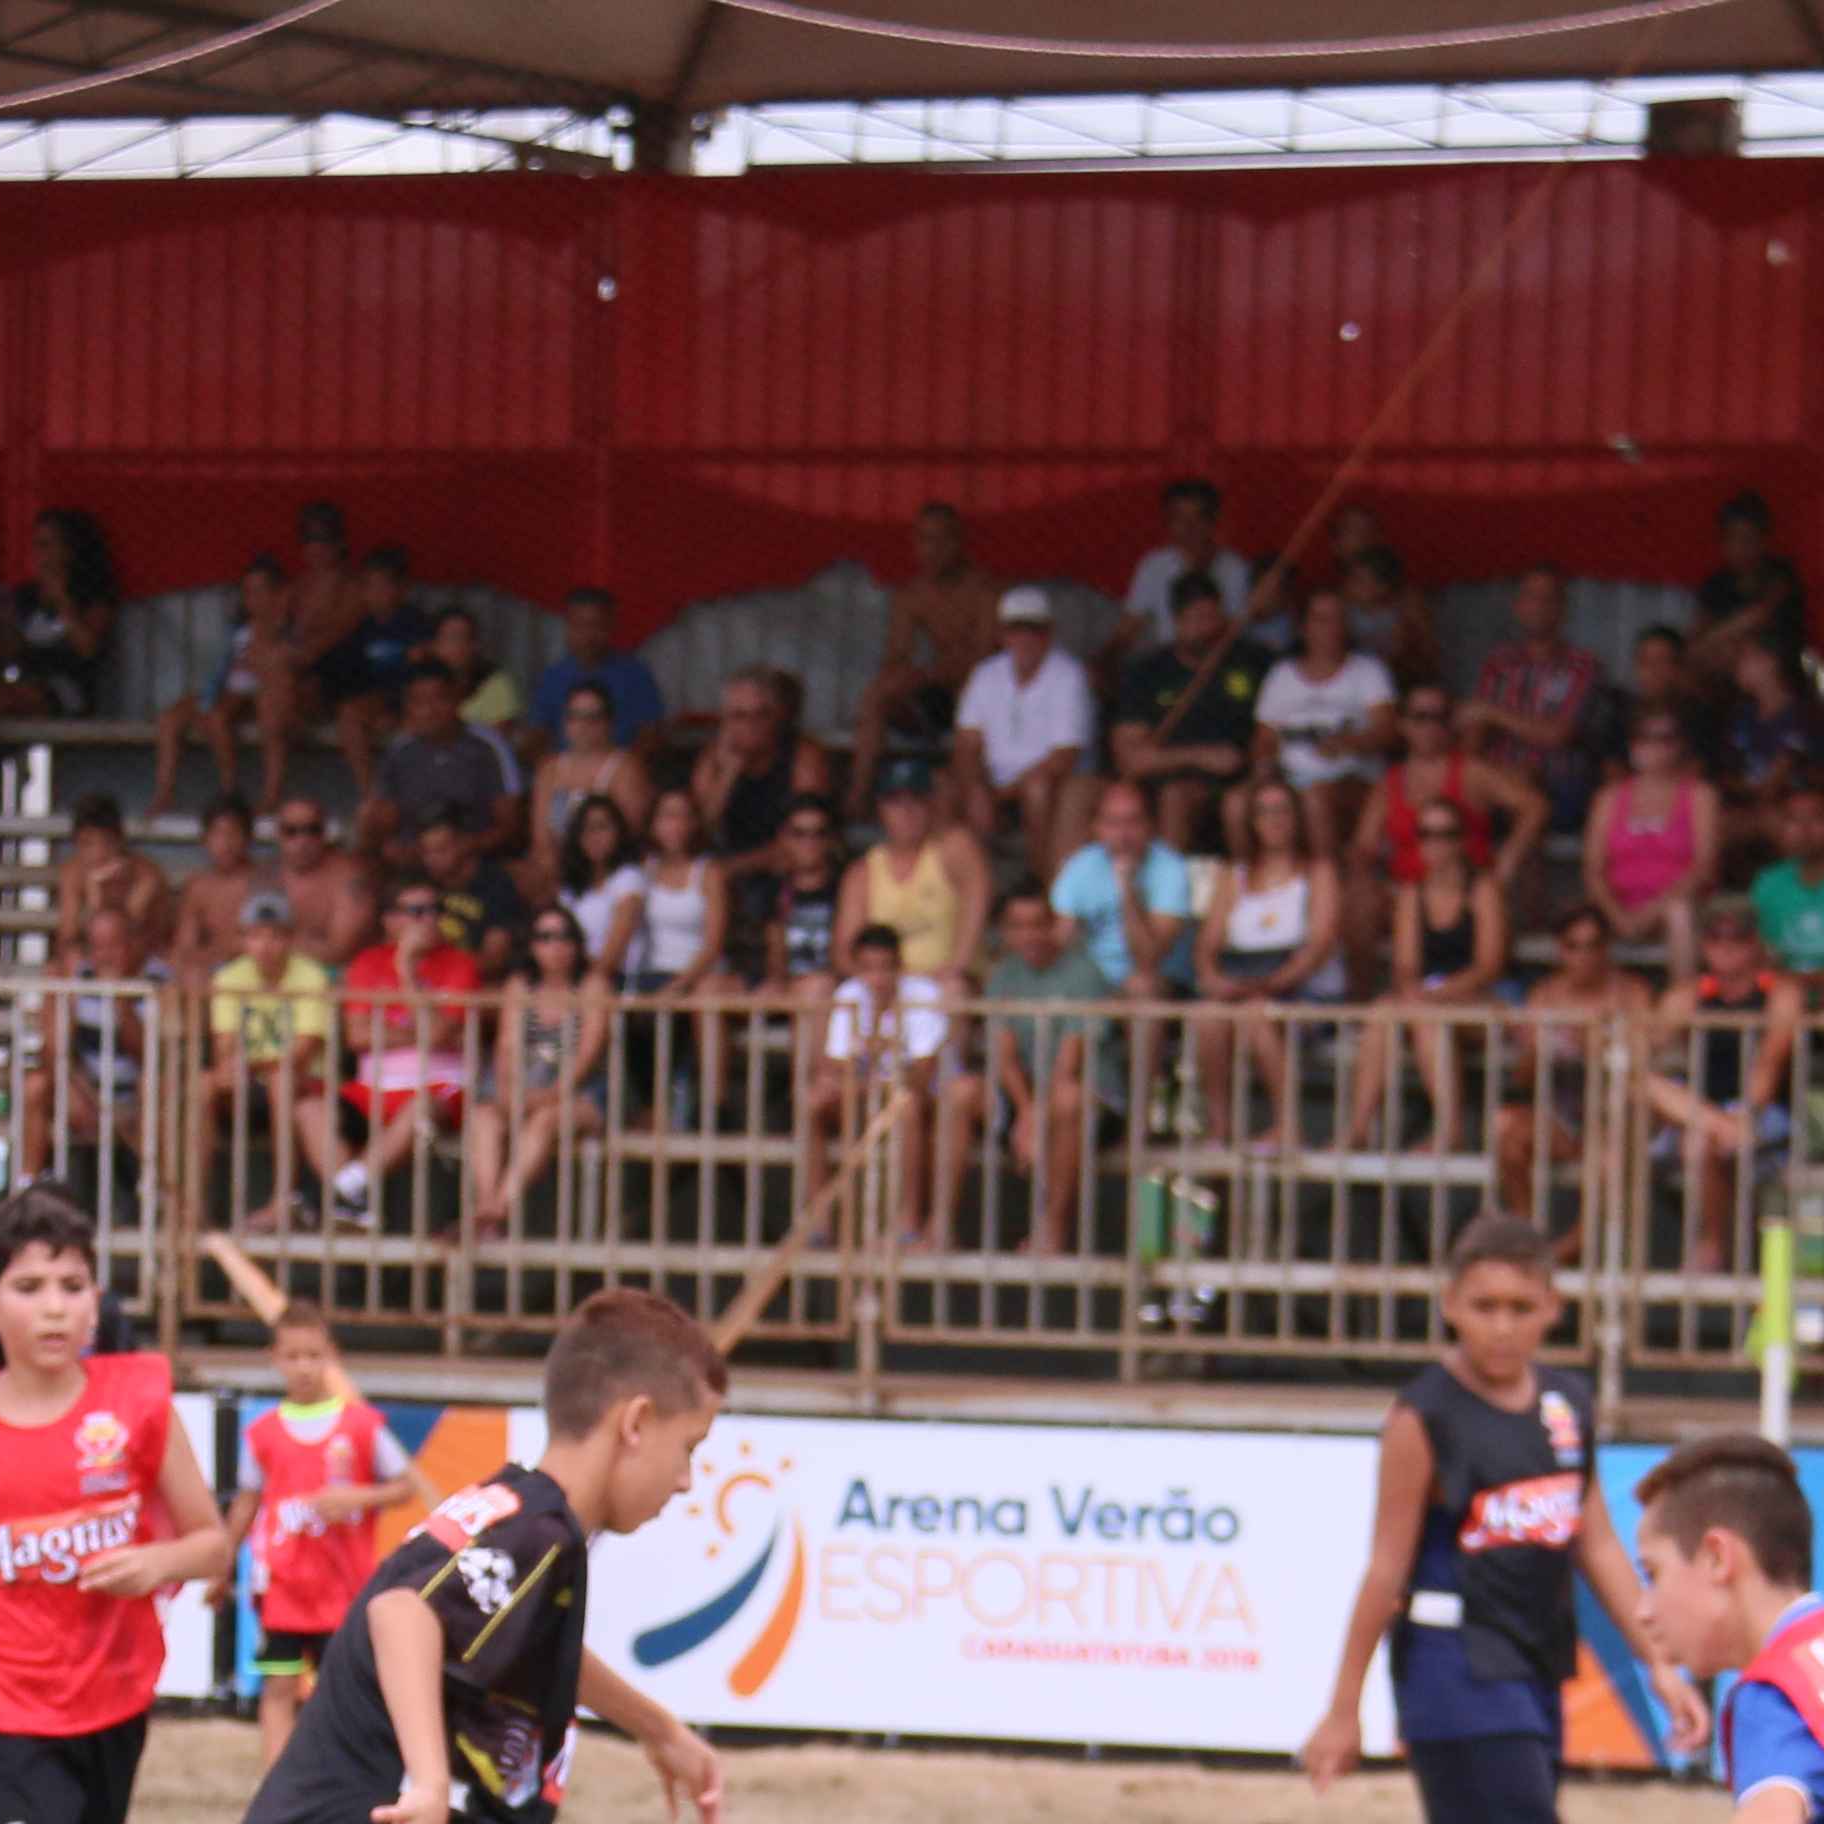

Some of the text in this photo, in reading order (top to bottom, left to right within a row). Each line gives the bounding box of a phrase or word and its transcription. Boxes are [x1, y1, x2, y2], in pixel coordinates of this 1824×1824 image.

[838, 1478, 1241, 1545] Arena Verão
[819, 1543, 1259, 1634] ESPORTIVA
